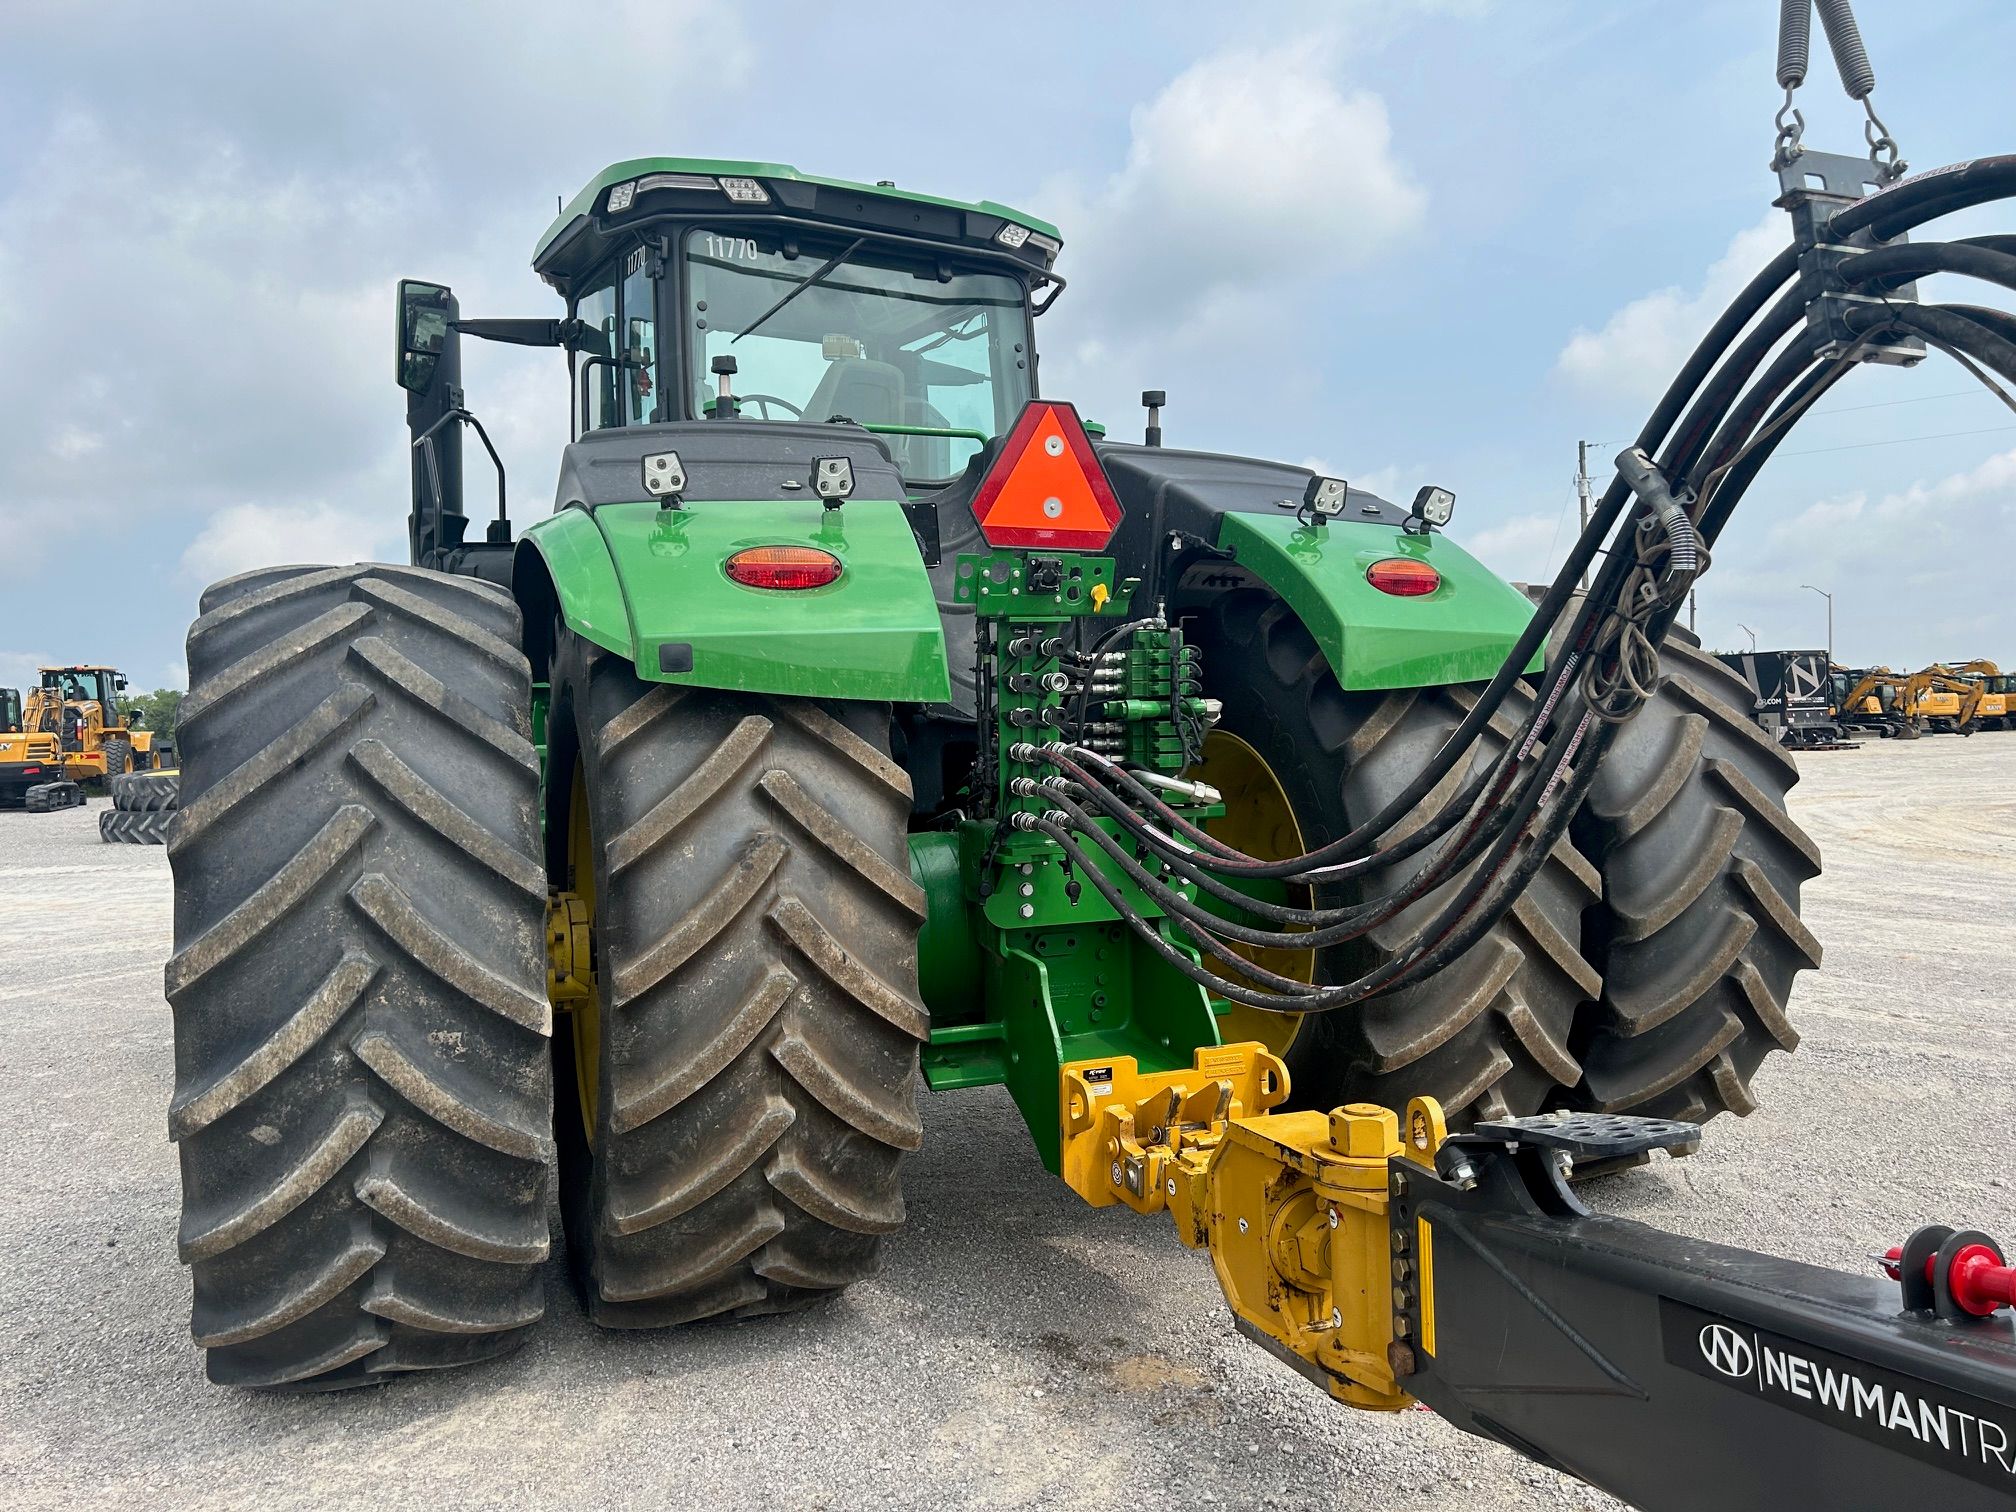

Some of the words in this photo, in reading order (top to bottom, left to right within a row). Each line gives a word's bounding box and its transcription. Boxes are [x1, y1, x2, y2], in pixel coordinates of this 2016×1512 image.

[627, 245, 646, 276] 11770
[706, 235, 758, 260] 11770
[1523, 711, 1547, 749] BESTFLEX
[1763, 1346, 2016, 1475] NEWMANTR
